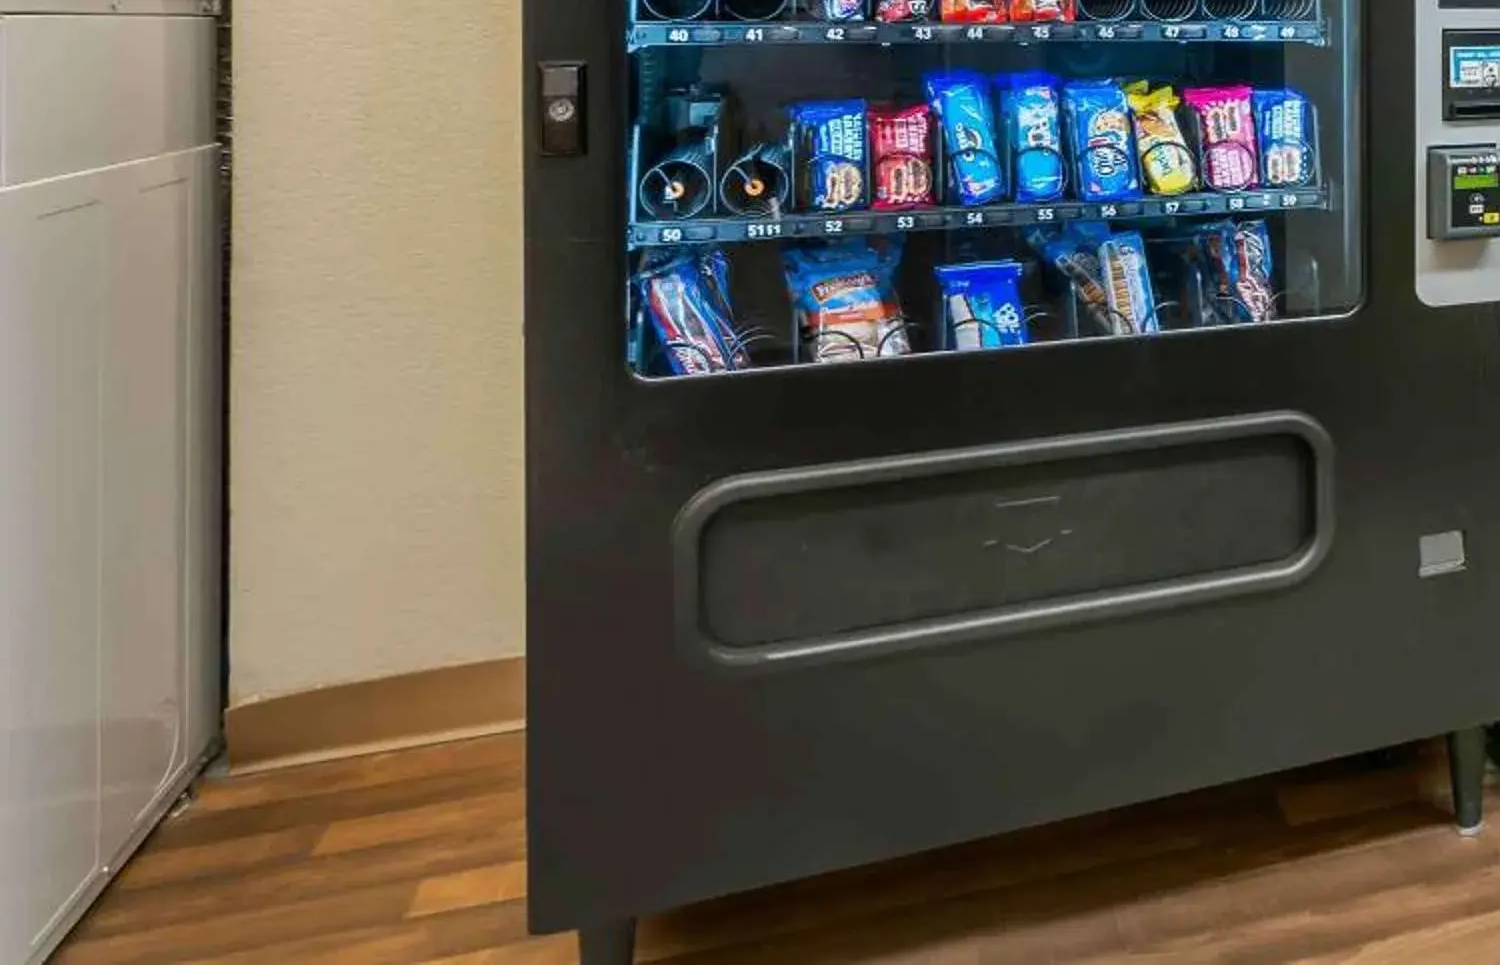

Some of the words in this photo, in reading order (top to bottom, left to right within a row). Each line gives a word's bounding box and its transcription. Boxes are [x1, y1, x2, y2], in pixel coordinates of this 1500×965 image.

[669, 28, 689, 41] 40
[745, 28, 763, 41] 41
[826, 28, 845, 40] 42
[915, 27, 932, 40] 43
[966, 27, 983, 40] 44
[967, 212, 983, 224] 54
[1037, 208, 1054, 220] 55
[825, 220, 842, 233] 52
[897, 217, 914, 229] 53
[662, 229, 681, 242] 50
